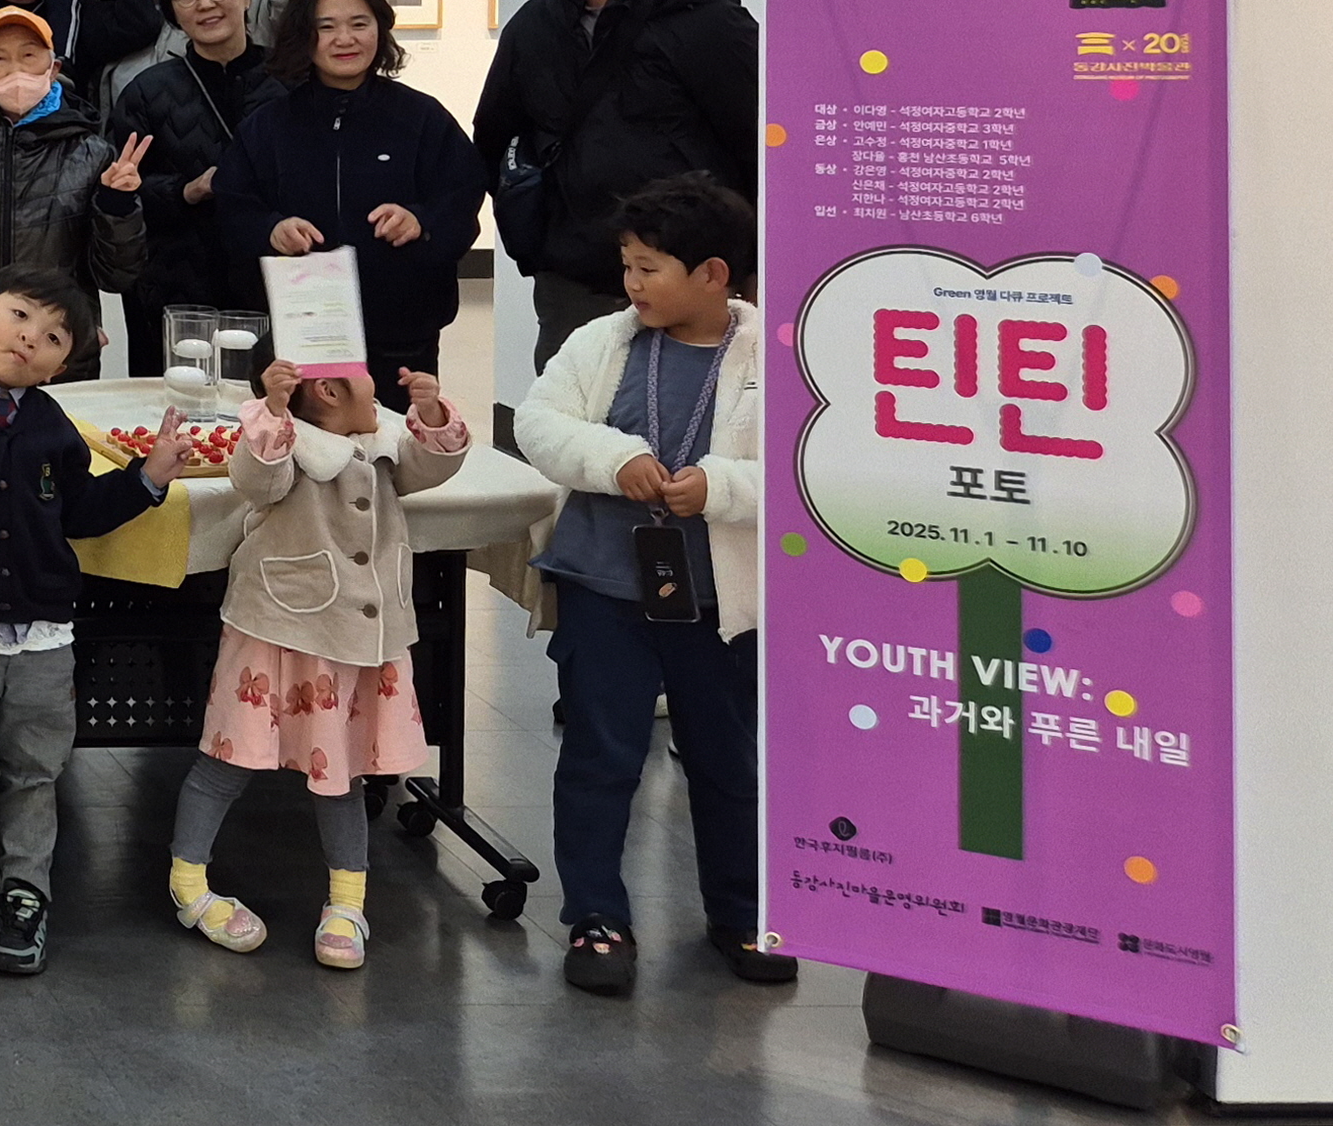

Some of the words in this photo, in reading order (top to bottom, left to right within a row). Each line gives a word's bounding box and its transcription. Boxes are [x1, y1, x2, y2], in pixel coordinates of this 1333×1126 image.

[1142, 32, 1181, 54] 20
[814, 104, 837, 115] 대상
[899, 105, 991, 119] 석정여자고등학교
[994, 107, 1026, 119] 2학년
[814, 119, 837, 131] 금상
[982, 123, 1014, 135] 3학년
[982, 139, 1013, 151] 1학년
[999, 154, 1031, 167] 5학년
[982, 169, 1014, 181] 2학년
[992, 183, 1024, 196] 2학년
[992, 197, 1024, 210] 2학년
[970, 212, 1003, 225] 6학년
[933, 286, 972, 299] Green
[974, 288, 997, 302] 영월
[999, 290, 1024, 303] 다큐
[1025, 291, 1074, 305] 프로젝트
[873, 307, 1108, 461] 틴틴
[946, 464, 1032, 506] 포토
[818, 633, 956, 682] YOUTH
[970, 654, 1095, 702] VIEW:
[907, 693, 1016, 741] 과거와
[1026, 710, 1102, 755] 푸른
[1115, 724, 1192, 768] 내일
